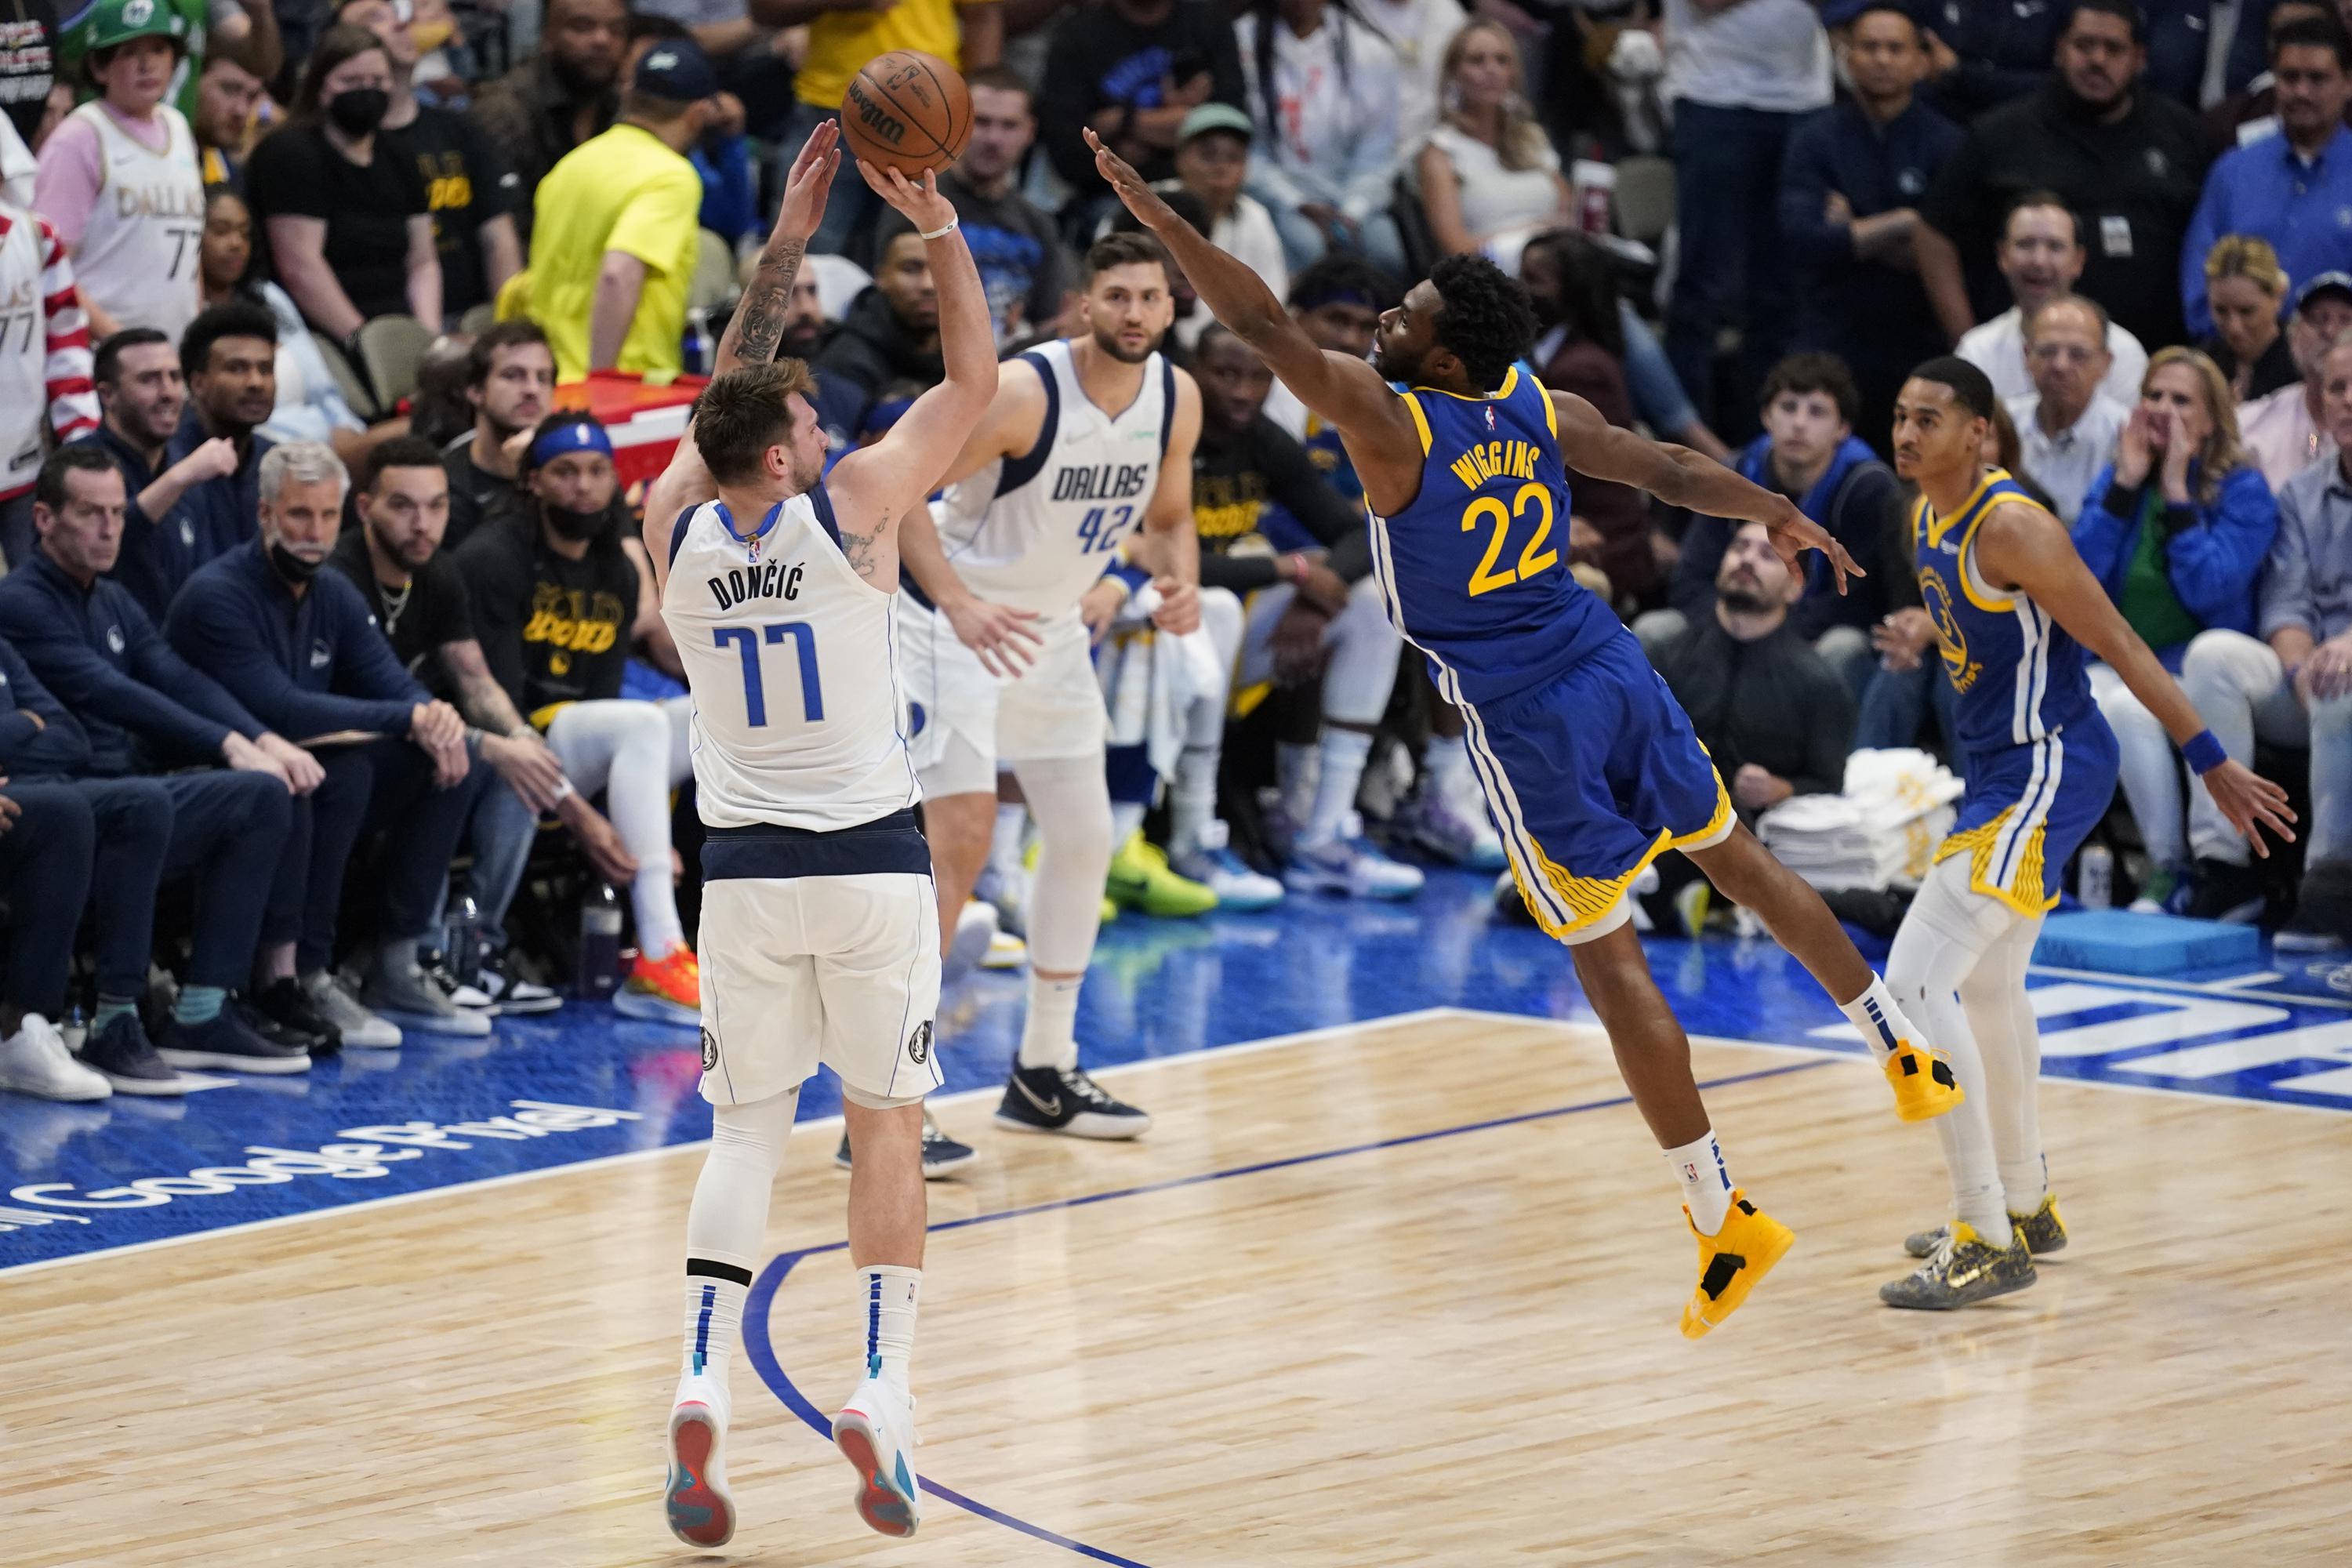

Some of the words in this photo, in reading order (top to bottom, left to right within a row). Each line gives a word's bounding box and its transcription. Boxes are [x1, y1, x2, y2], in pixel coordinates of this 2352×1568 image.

[1051, 463, 1149, 502] DALLAS
[1450, 440, 1541, 492] WIGGINS
[1076, 505, 1134, 555] 42
[1461, 481, 1558, 597] 22
[707, 558, 806, 612] DONČIĆ
[712, 620, 826, 728] 77
[10, 1143, 424, 1208] Google
